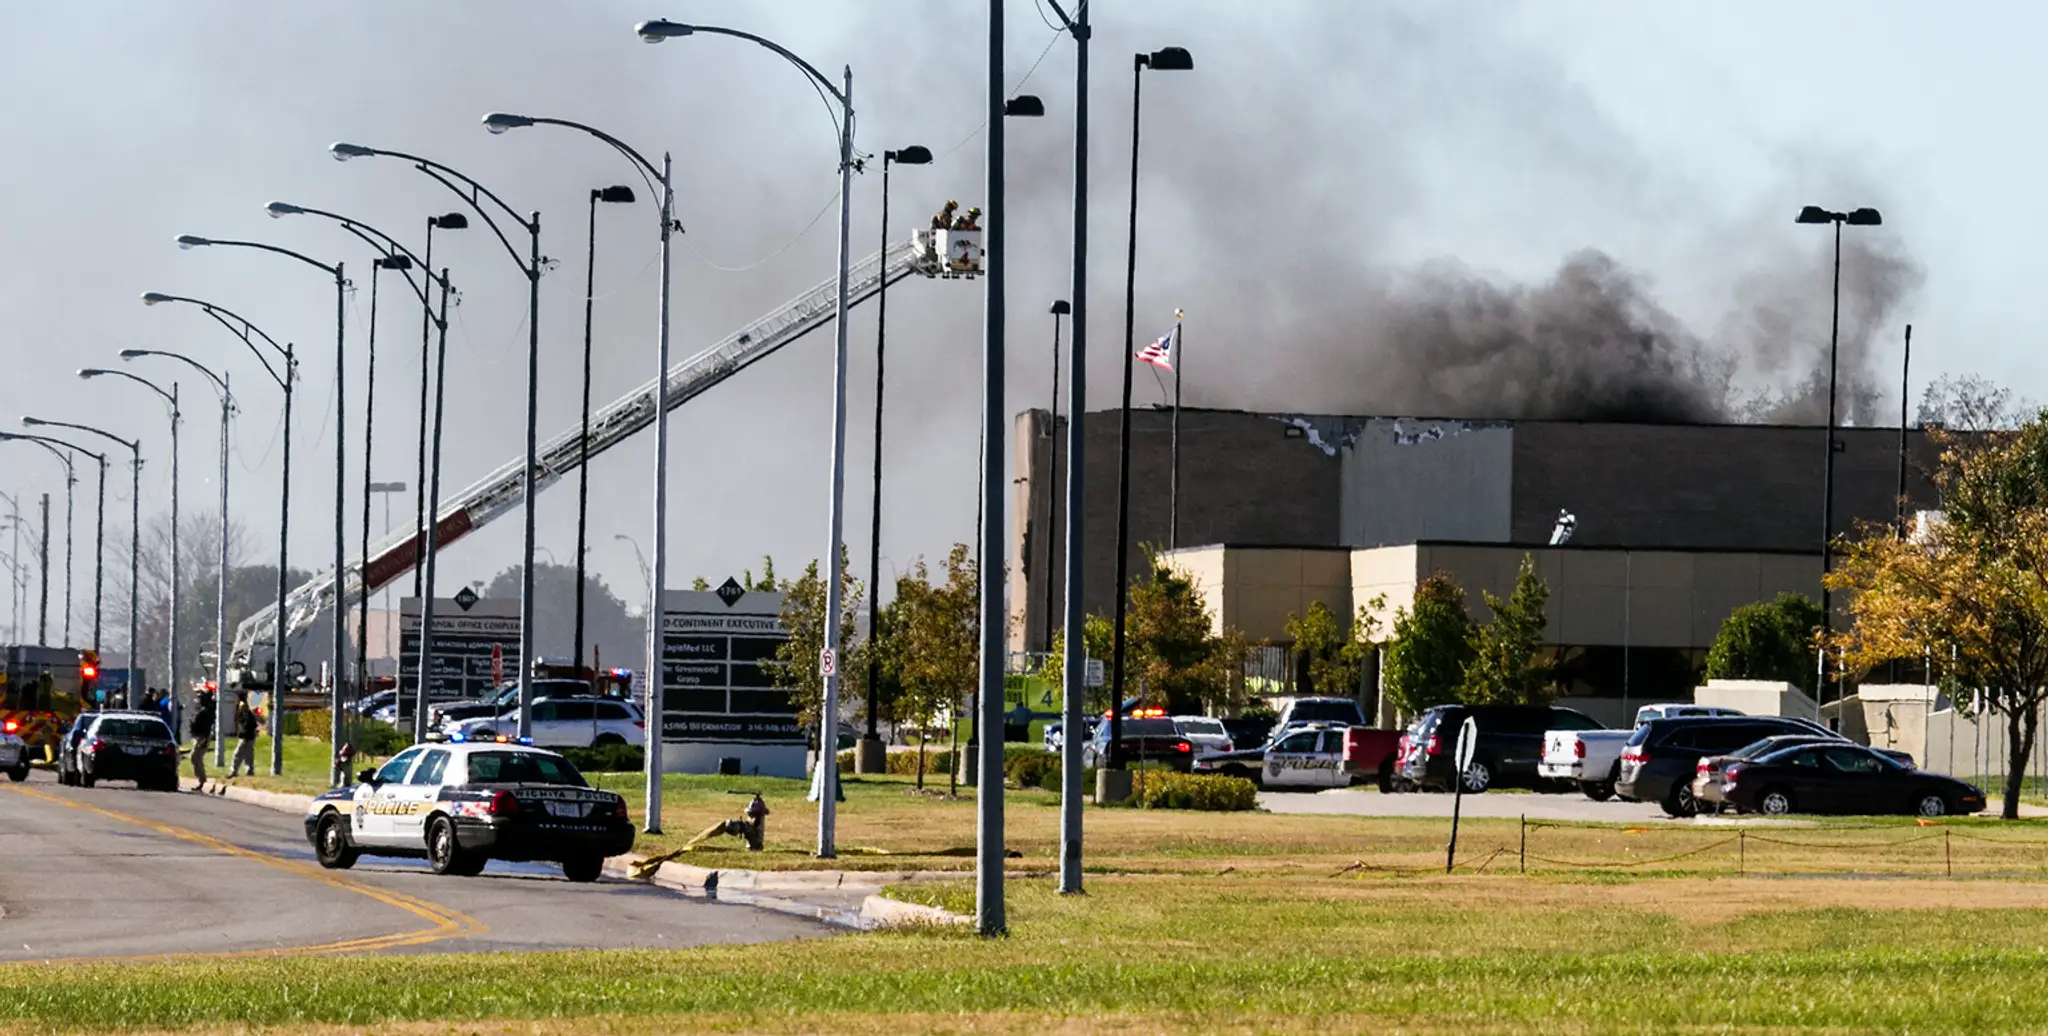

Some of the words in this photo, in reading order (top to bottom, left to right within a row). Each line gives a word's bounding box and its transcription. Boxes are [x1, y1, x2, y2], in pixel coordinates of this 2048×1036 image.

[664, 618, 723, 628] D-CONTINENT
[727, 619, 772, 630] EXECUTIVE
[675, 665, 719, 675] Greenwood
[1040, 690, 1053, 708] 4
[689, 723, 742, 732] INFORMATION
[514, 789, 567, 799] WICHITA
[576, 791, 618, 803] POLICE
[364, 800, 419, 815] POLICE
